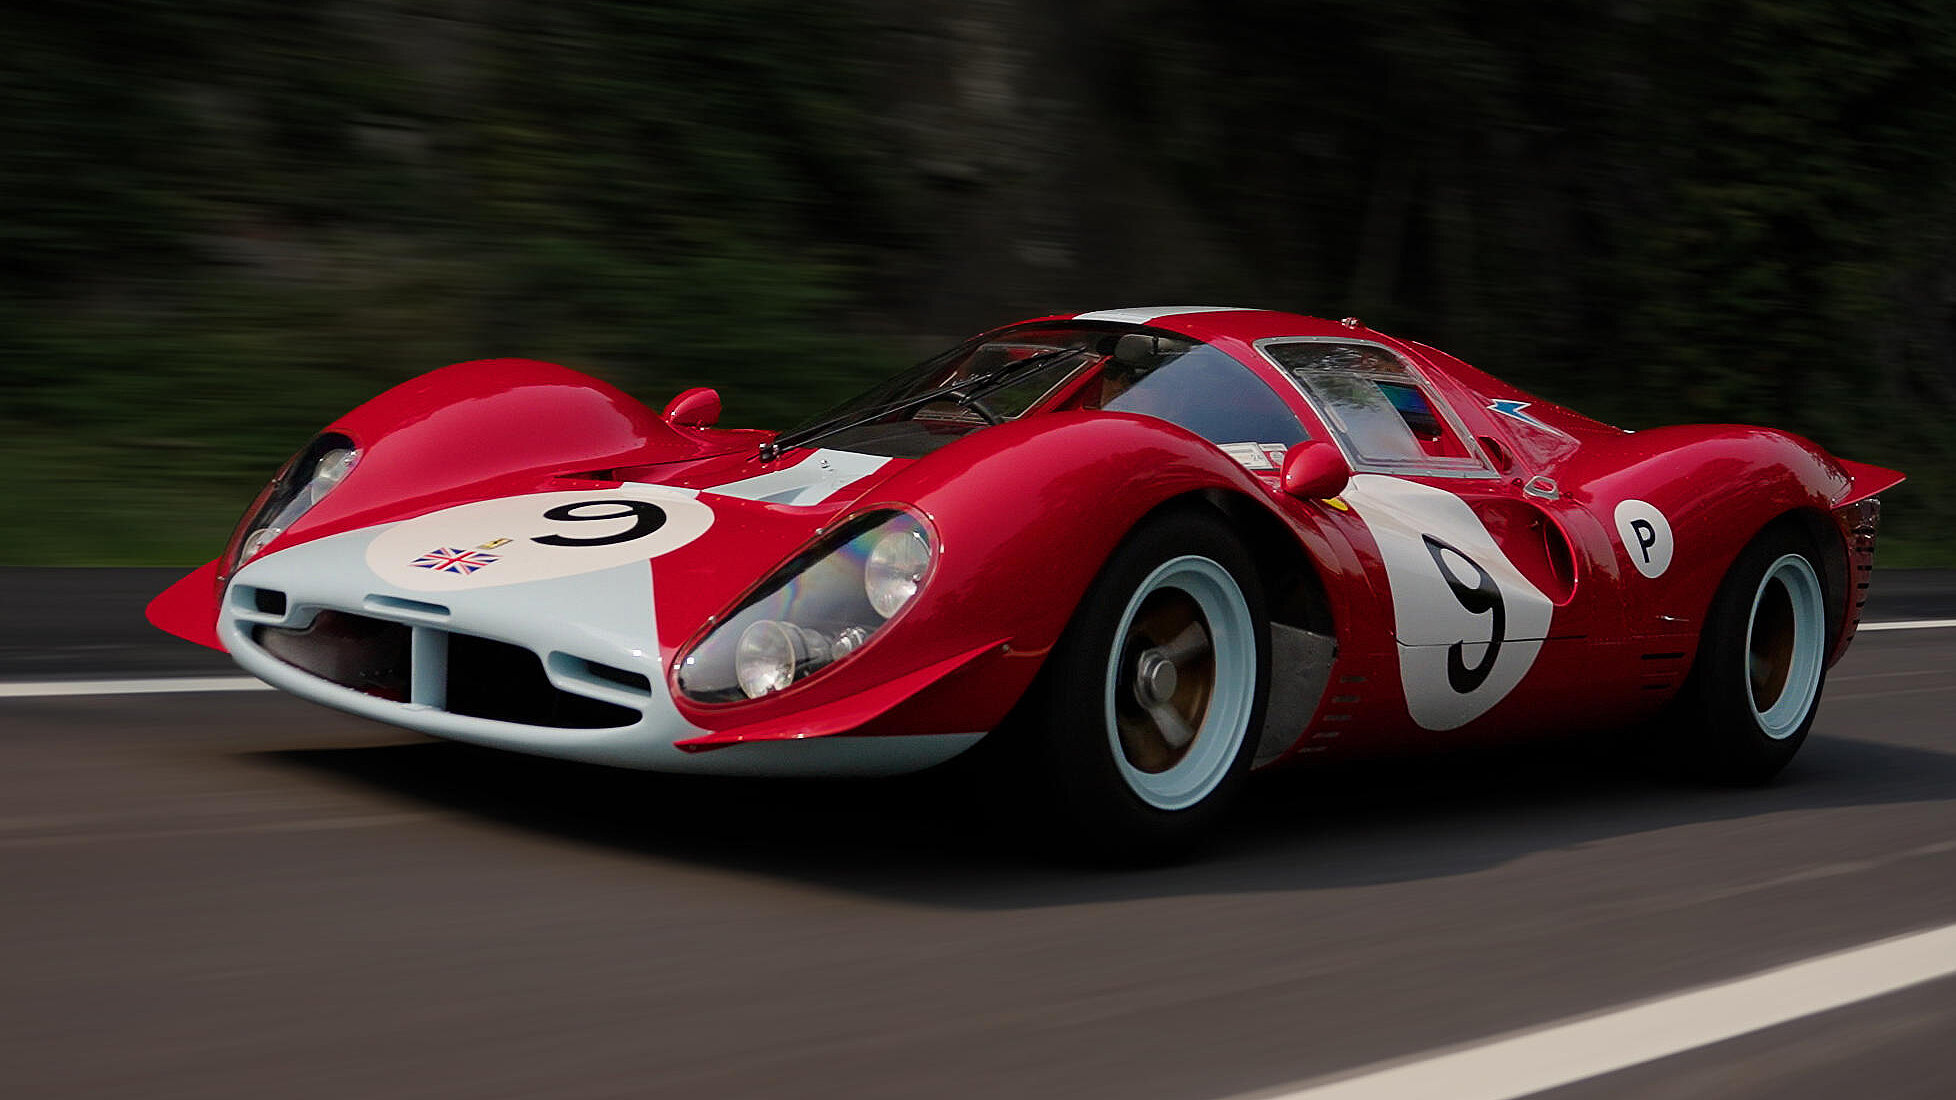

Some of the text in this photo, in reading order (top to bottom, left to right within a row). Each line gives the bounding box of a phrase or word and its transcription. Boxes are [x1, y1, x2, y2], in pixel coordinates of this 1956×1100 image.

[530, 500, 667, 547] 9
[1630, 519, 1656, 563] P
[1421, 533, 1506, 694] 9
